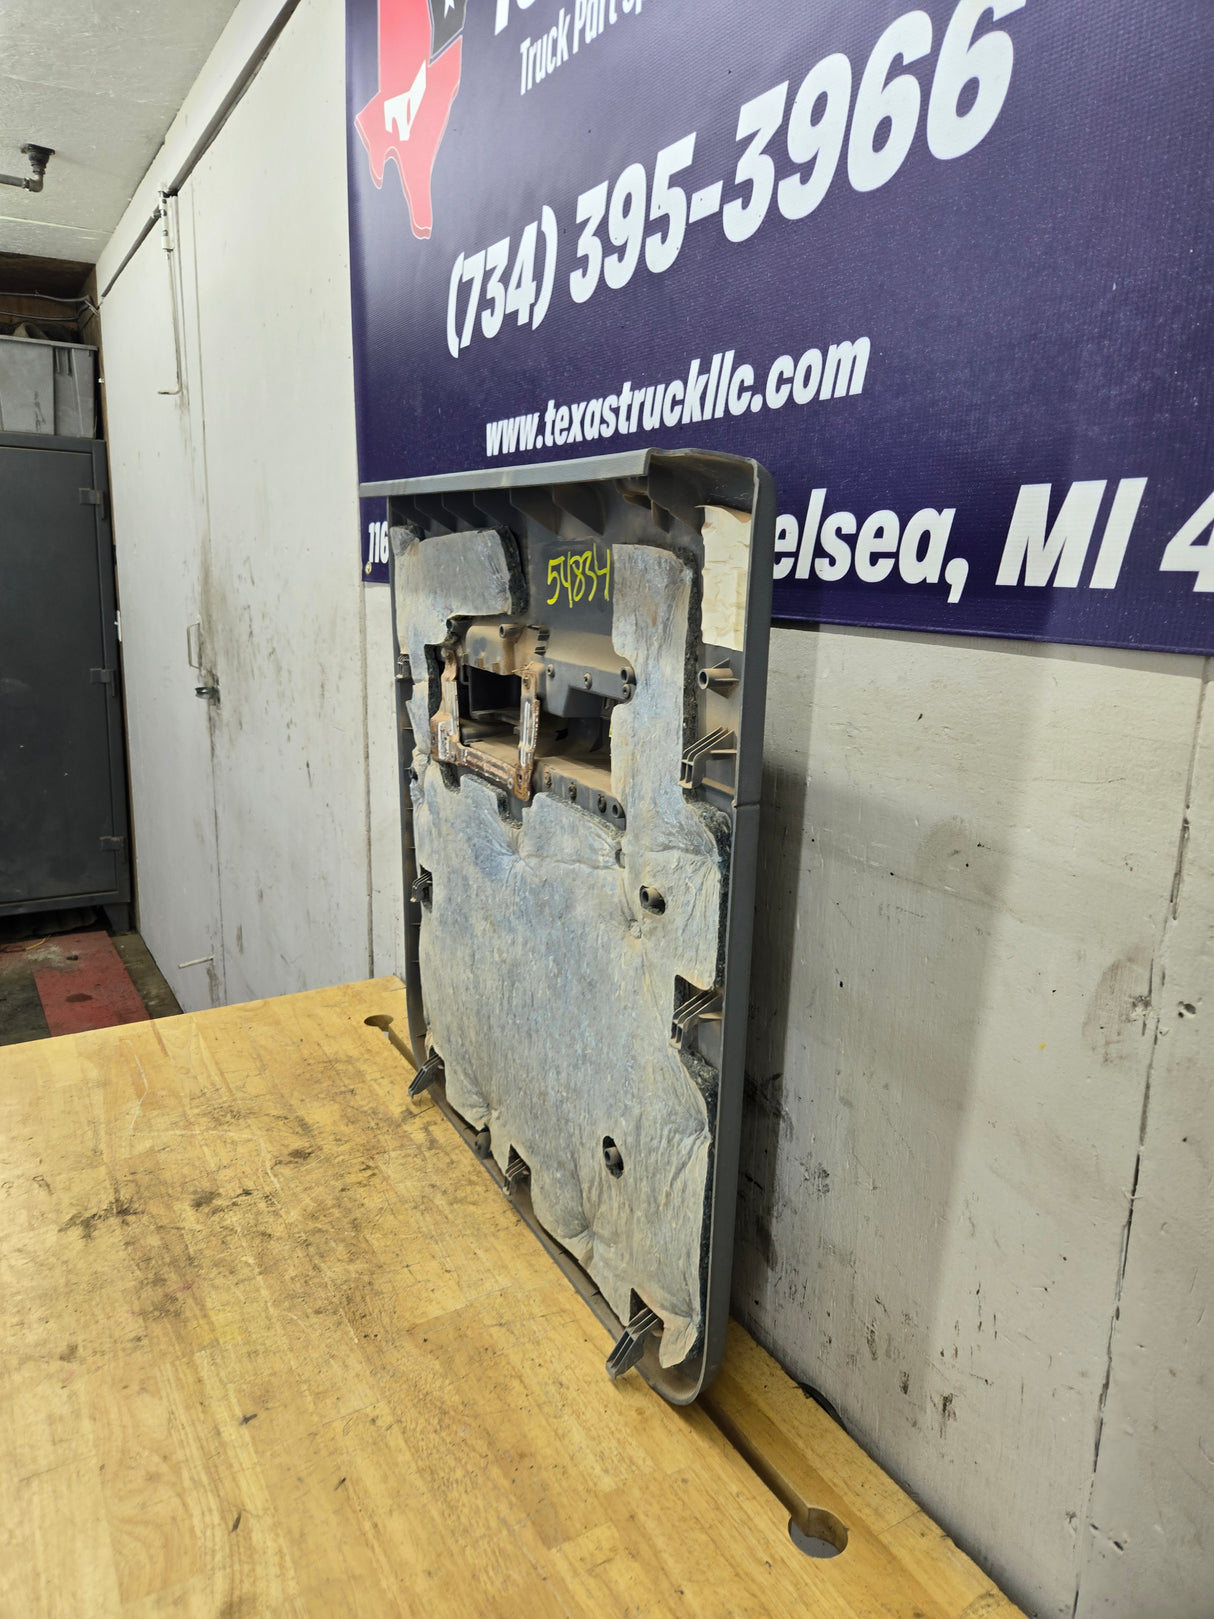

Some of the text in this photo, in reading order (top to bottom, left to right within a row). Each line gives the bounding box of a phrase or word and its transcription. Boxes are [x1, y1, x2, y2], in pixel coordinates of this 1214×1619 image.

[520, 8, 571, 95] Truck
[447, 0, 1027, 359] (734) 395-3966
[486, 336, 871, 457] www.texastruckllc.com
[547, 543, 611, 608] 54834
[995, 477, 1148, 589] MI
